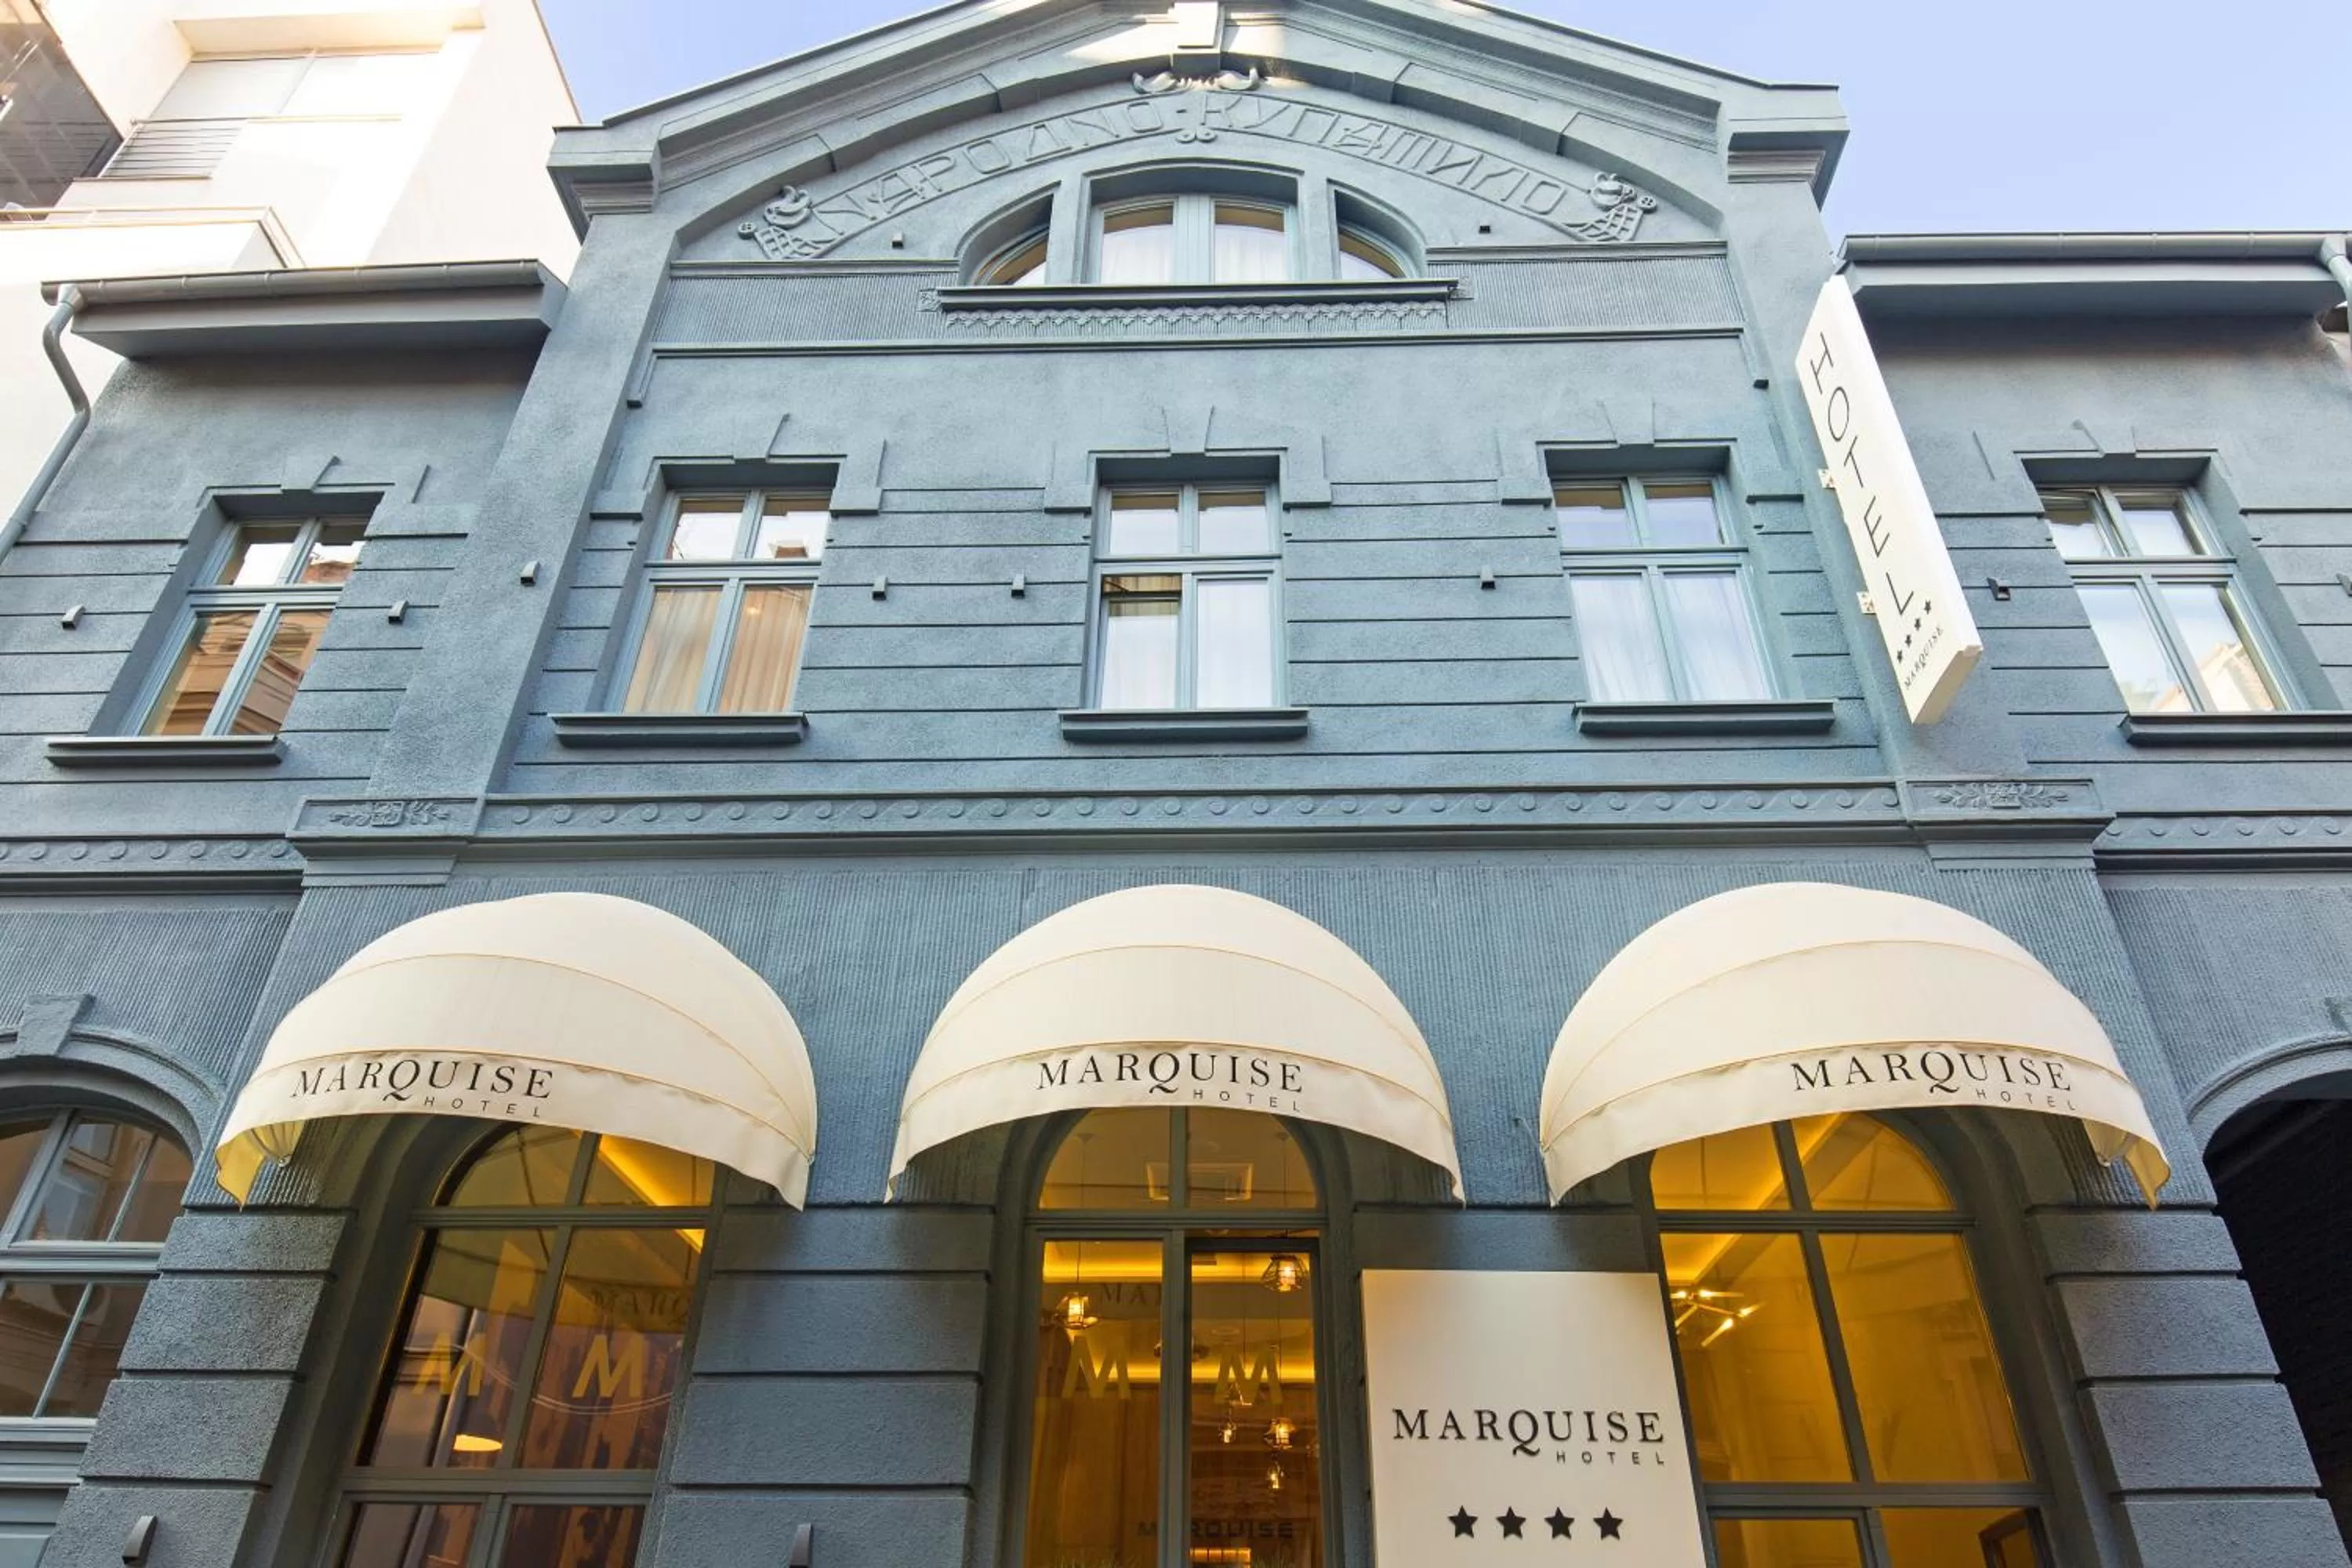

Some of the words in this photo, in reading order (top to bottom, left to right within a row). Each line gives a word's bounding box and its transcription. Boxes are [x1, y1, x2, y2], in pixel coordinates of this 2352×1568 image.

[1809, 332, 1914, 616] HOTEL
[289, 1059, 554, 1102] MARQUISE
[1036, 1051, 1303, 1094] MARQUISE
[1791, 1051, 2071, 1094] MARQUISE
[423, 1096, 541, 1118] HOTEL
[1192, 1089, 1302, 1112] HOTEL
[1975, 1087, 2077, 1111] HOTEL
[1392, 1409, 1664, 1457] MARQUISE
[1555, 1450, 1664, 1465] HOTEL
